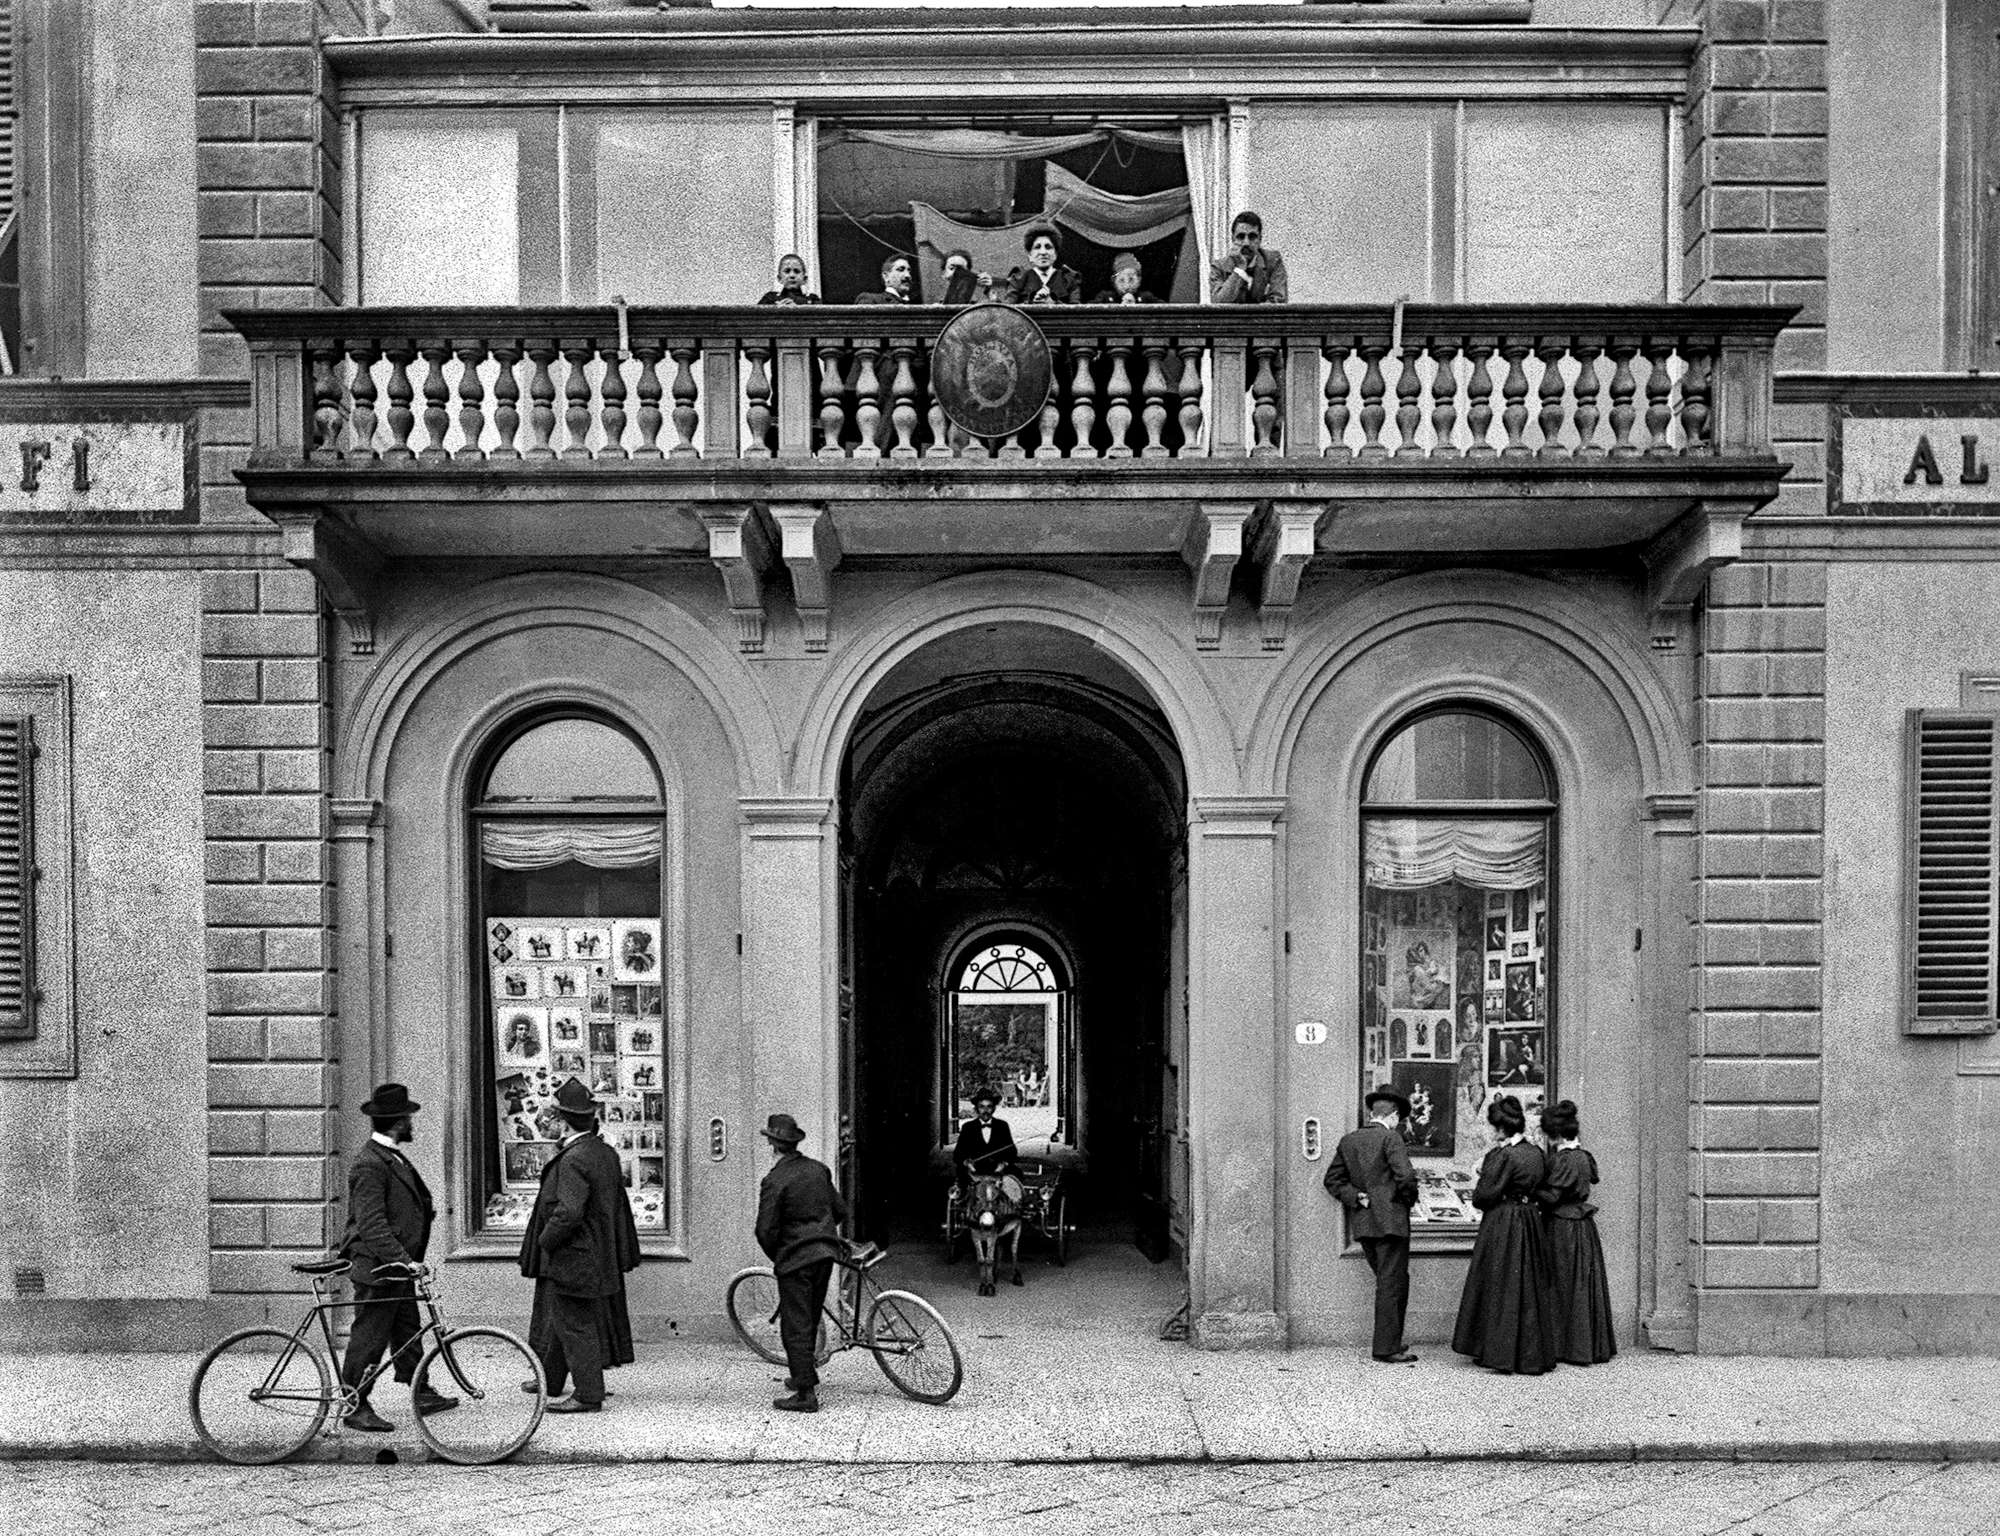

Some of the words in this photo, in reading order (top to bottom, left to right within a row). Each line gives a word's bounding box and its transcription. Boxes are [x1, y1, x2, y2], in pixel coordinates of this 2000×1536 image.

[0, 441, 91, 492] FI
[1903, 435, 1989, 485] AL
[1305, 1025, 1316, 1042] 8
